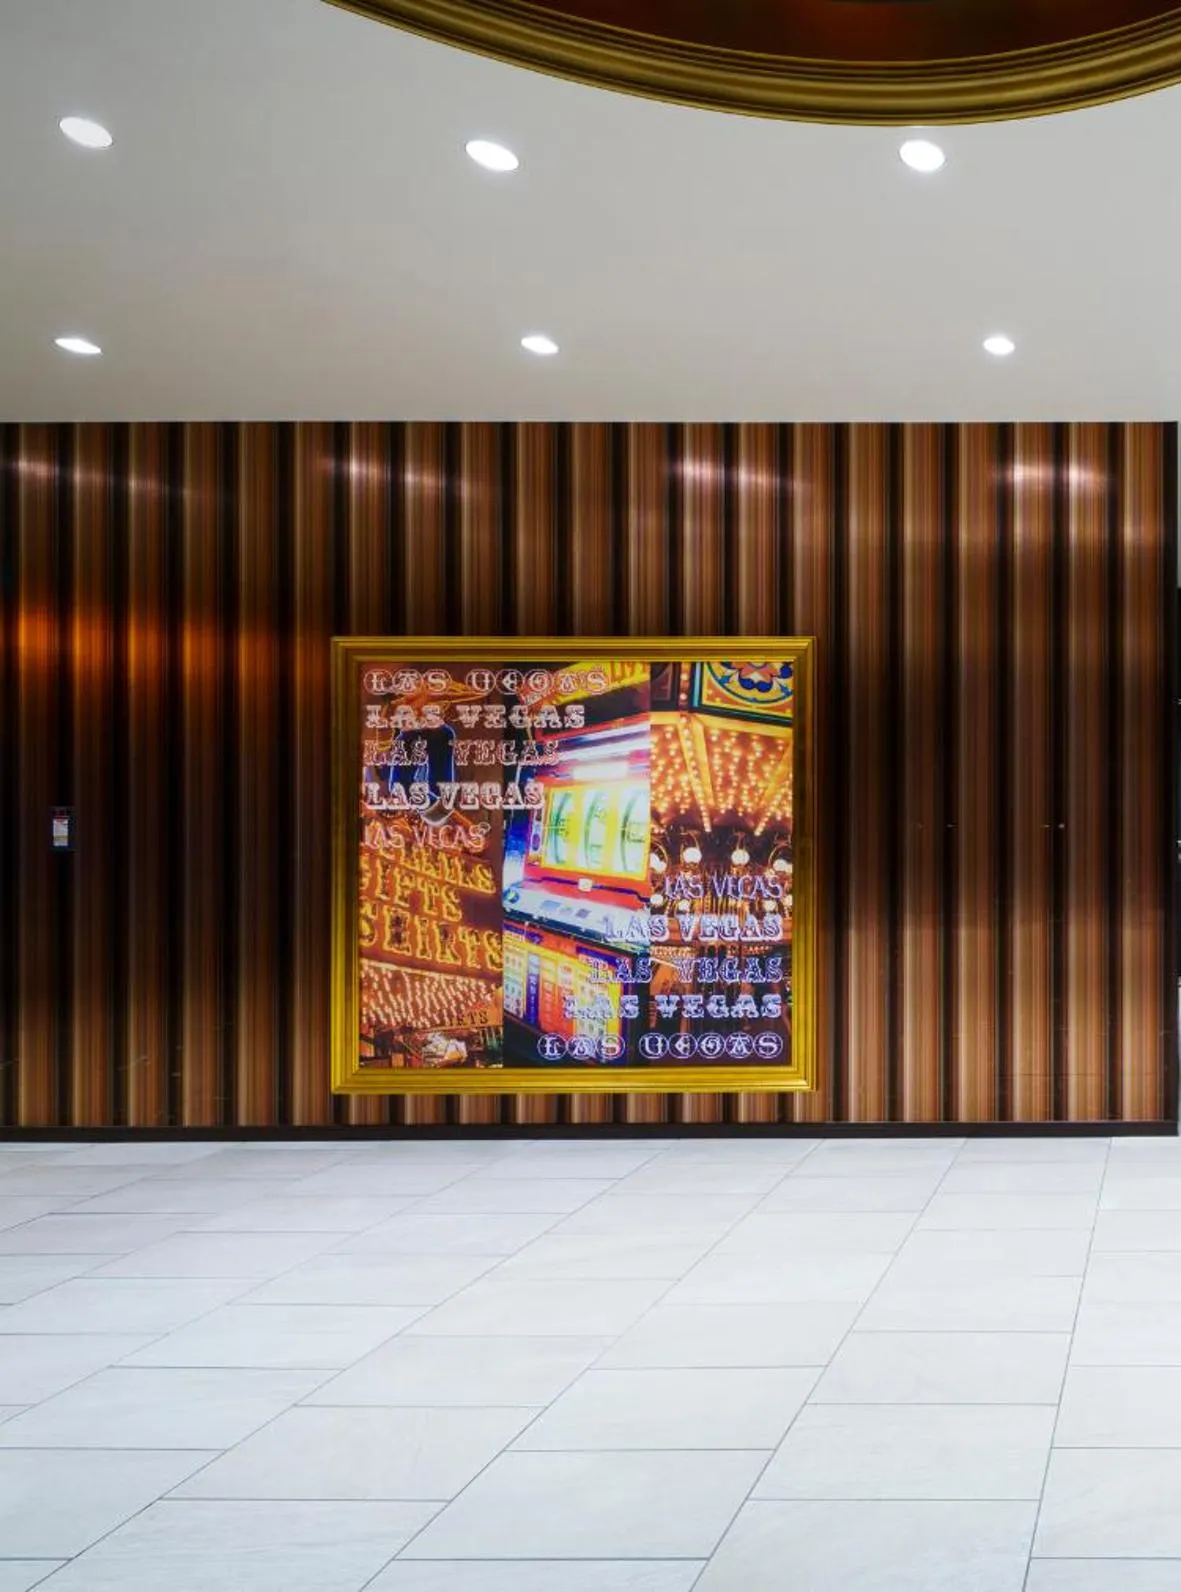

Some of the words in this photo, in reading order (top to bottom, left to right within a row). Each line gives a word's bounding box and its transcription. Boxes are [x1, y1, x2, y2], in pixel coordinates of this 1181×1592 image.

[364, 668, 452, 696] LAS
[364, 704, 444, 729] LAS
[456, 704, 586, 729] VEGAS
[363, 740, 429, 766] LAS
[450, 740, 560, 766] VEGAS
[363, 781, 430, 811] LAS
[435, 781, 546, 811] VEGAS
[361, 823, 406, 849] LAS
[664, 873, 704, 900] LAS
[601, 914, 670, 942] LAS
[676, 913, 784, 942] VEGAS
[588, 956, 653, 984] LAS
[673, 956, 784, 984] VEGAS
[564, 994, 640, 1020] LAS
[655, 994, 784, 1020] VEGAS
[537, 1032, 626, 1061] LAS
